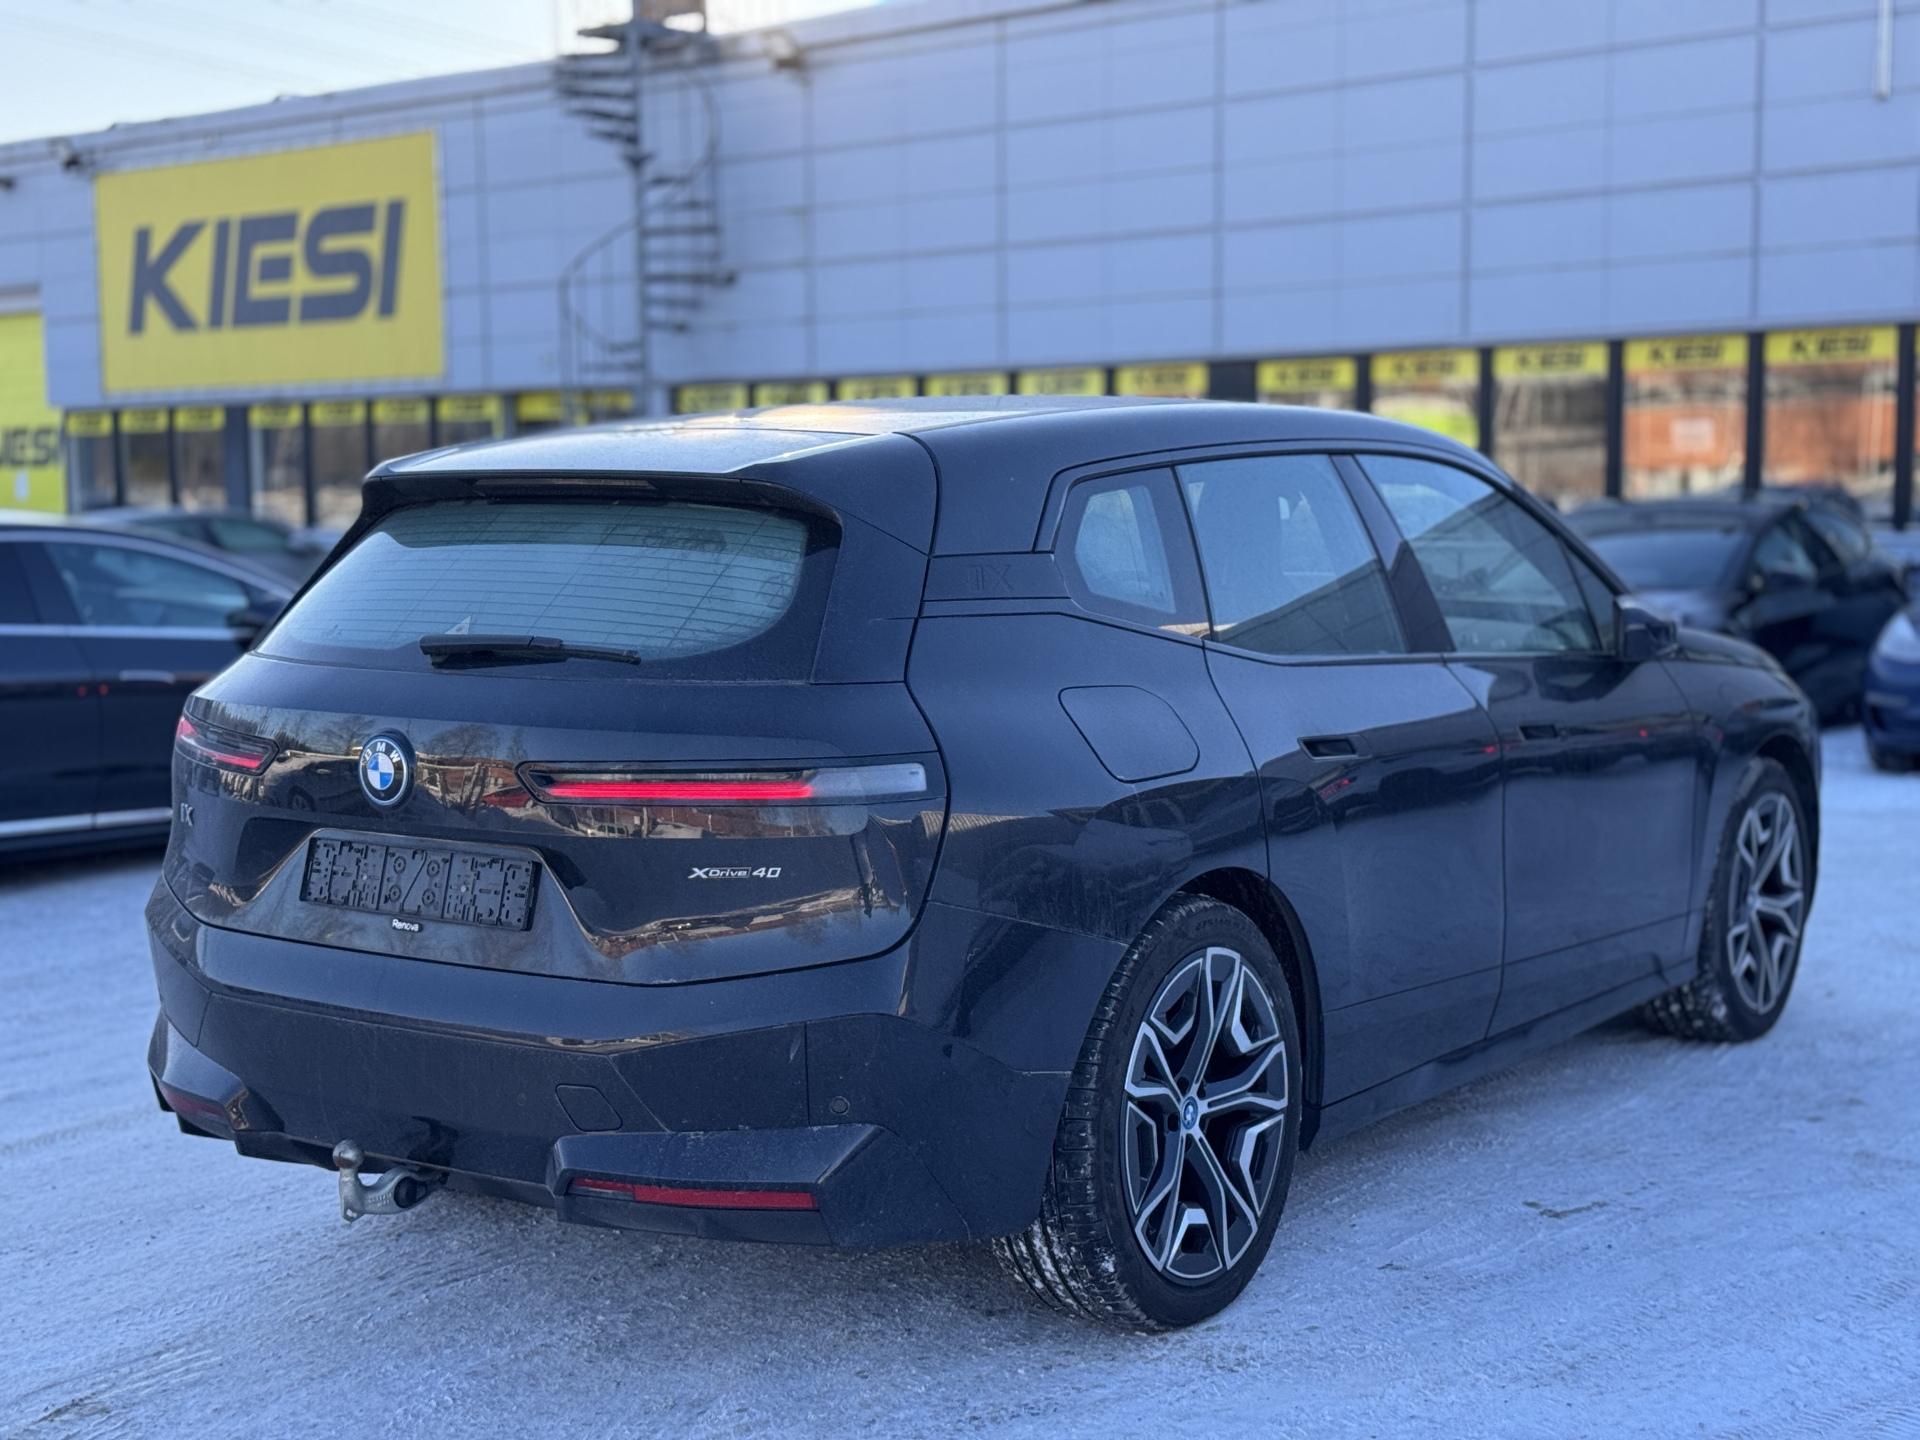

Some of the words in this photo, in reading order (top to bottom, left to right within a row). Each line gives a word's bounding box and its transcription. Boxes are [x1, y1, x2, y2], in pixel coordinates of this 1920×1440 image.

[127, 197, 407, 336] KIESI
[364, 741, 402, 763] BMW
[752, 867, 782, 878] 40
